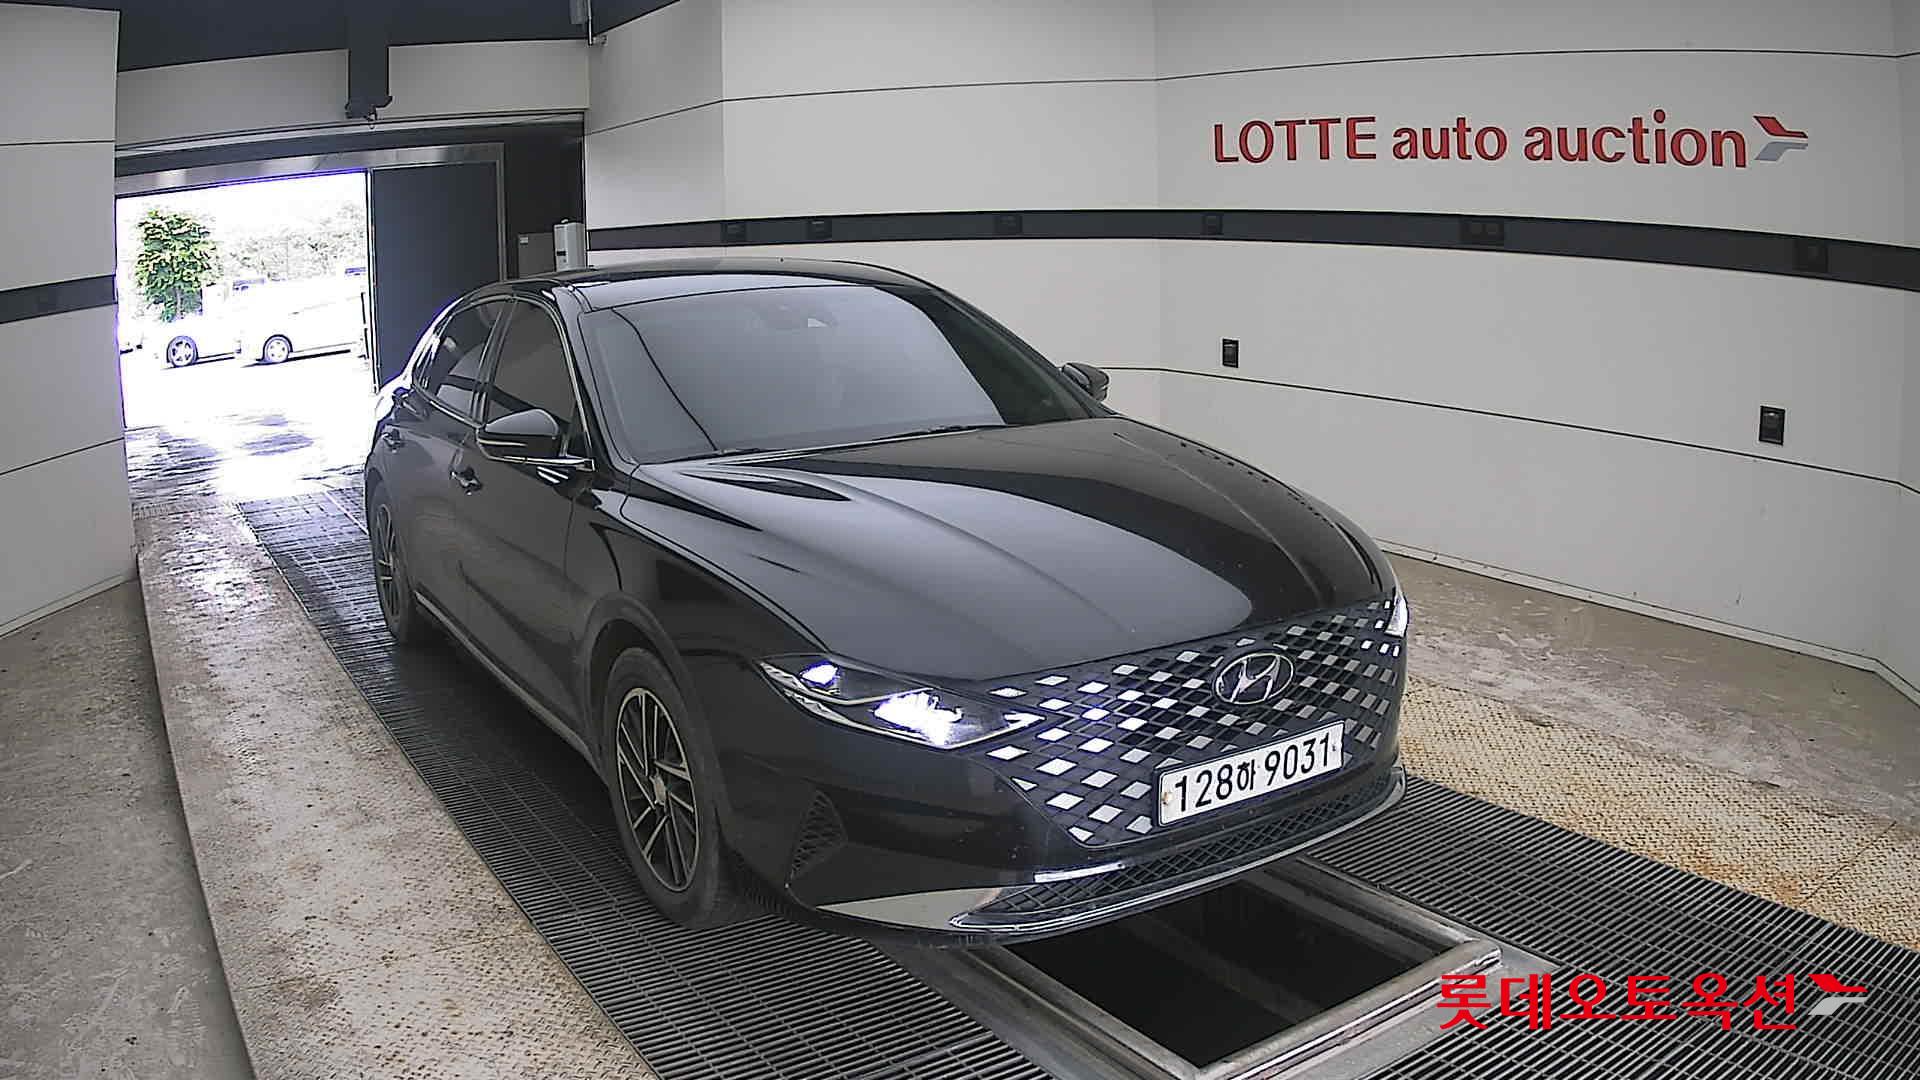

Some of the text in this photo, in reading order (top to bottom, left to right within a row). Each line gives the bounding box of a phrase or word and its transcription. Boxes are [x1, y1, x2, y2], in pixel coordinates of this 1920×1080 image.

[1213, 110, 1747, 168] LOTTE auto auction
[1175, 732, 1330, 812] 128하 9031
